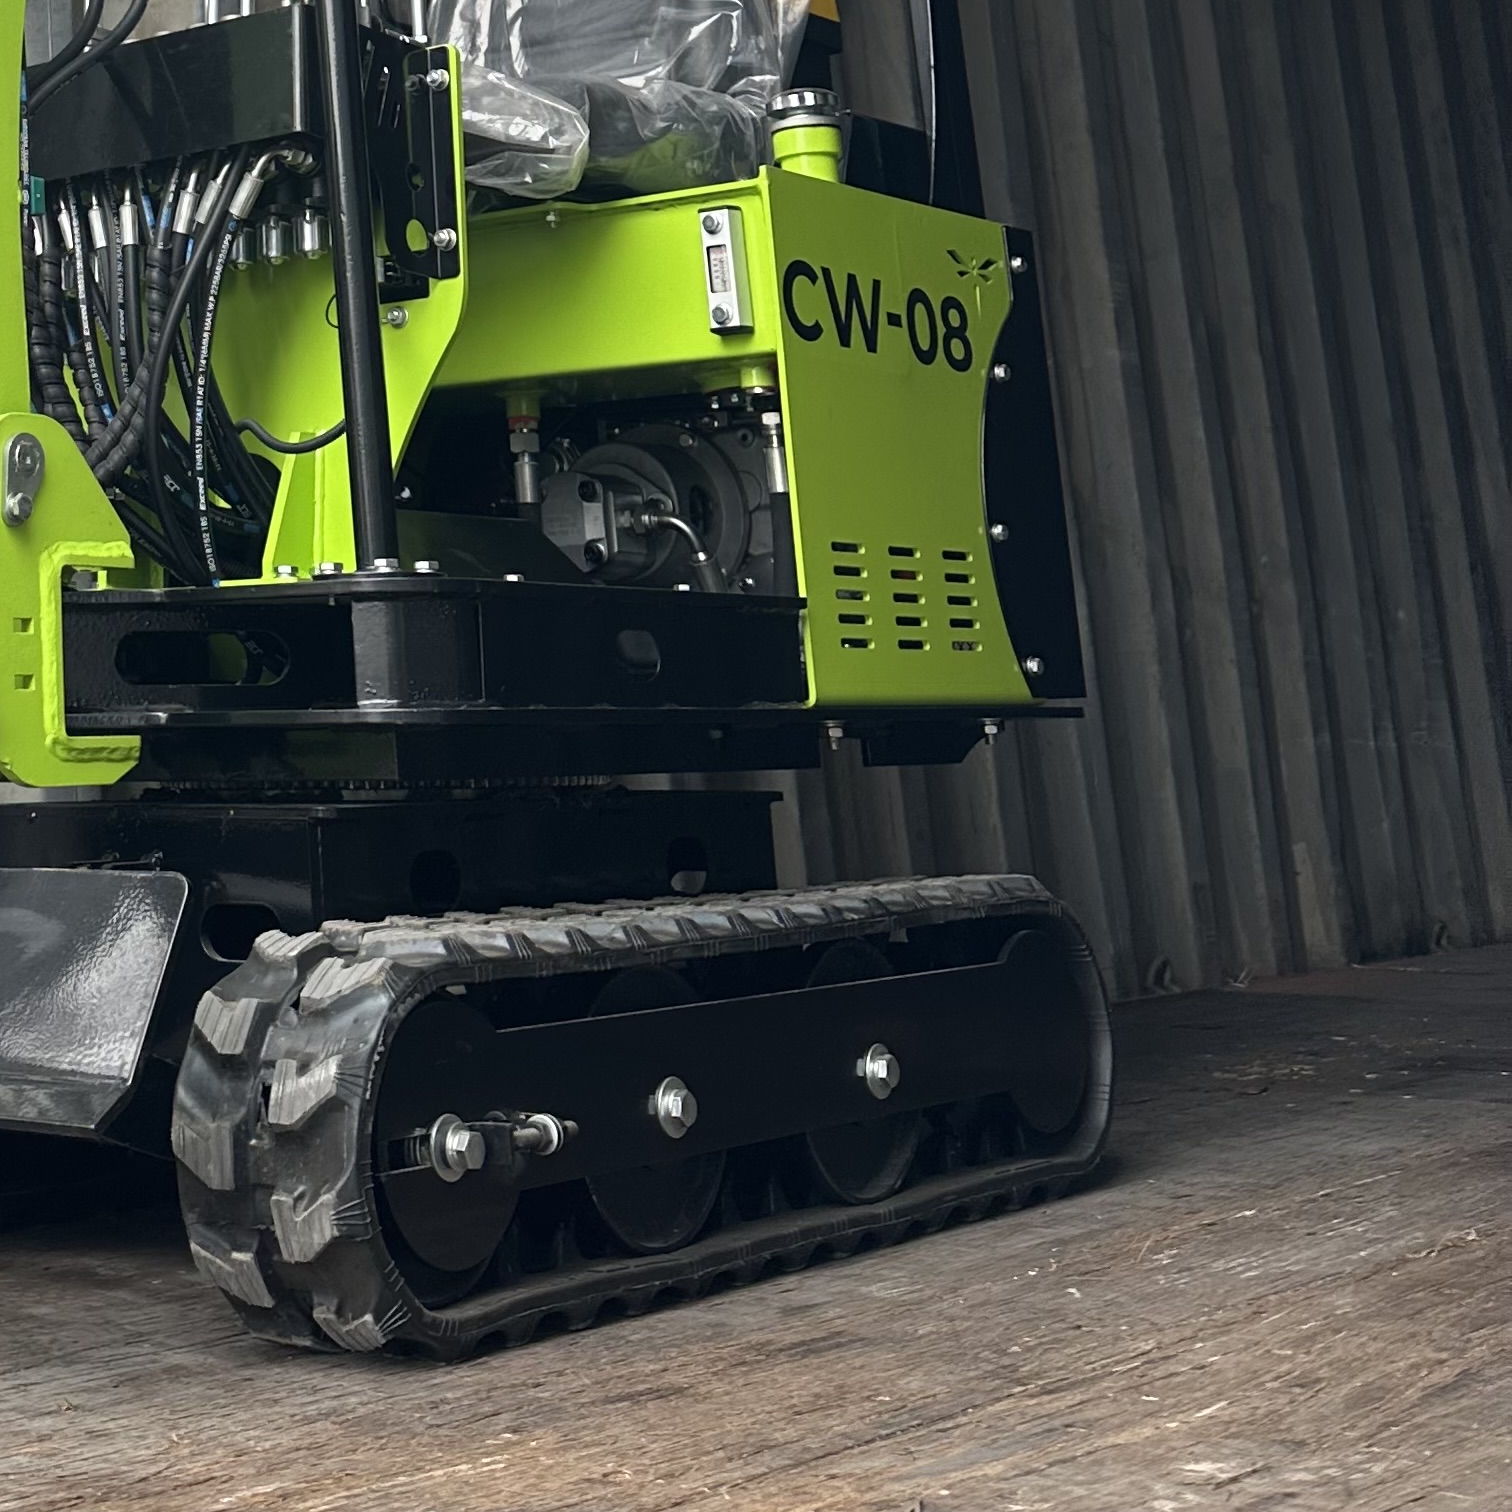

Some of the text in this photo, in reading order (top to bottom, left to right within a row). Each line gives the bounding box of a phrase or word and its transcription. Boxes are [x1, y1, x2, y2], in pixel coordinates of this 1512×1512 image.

[80, 304, 90, 336] Exceed
[782, 259, 973, 372] CW-08
[88, 357, 104, 397] ISO18752
[196, 385, 205, 406] R1AT
[195, 443, 204, 471] EN853
[197, 477, 207, 511] Exceed
[203, 532, 217, 573] ISO18752
